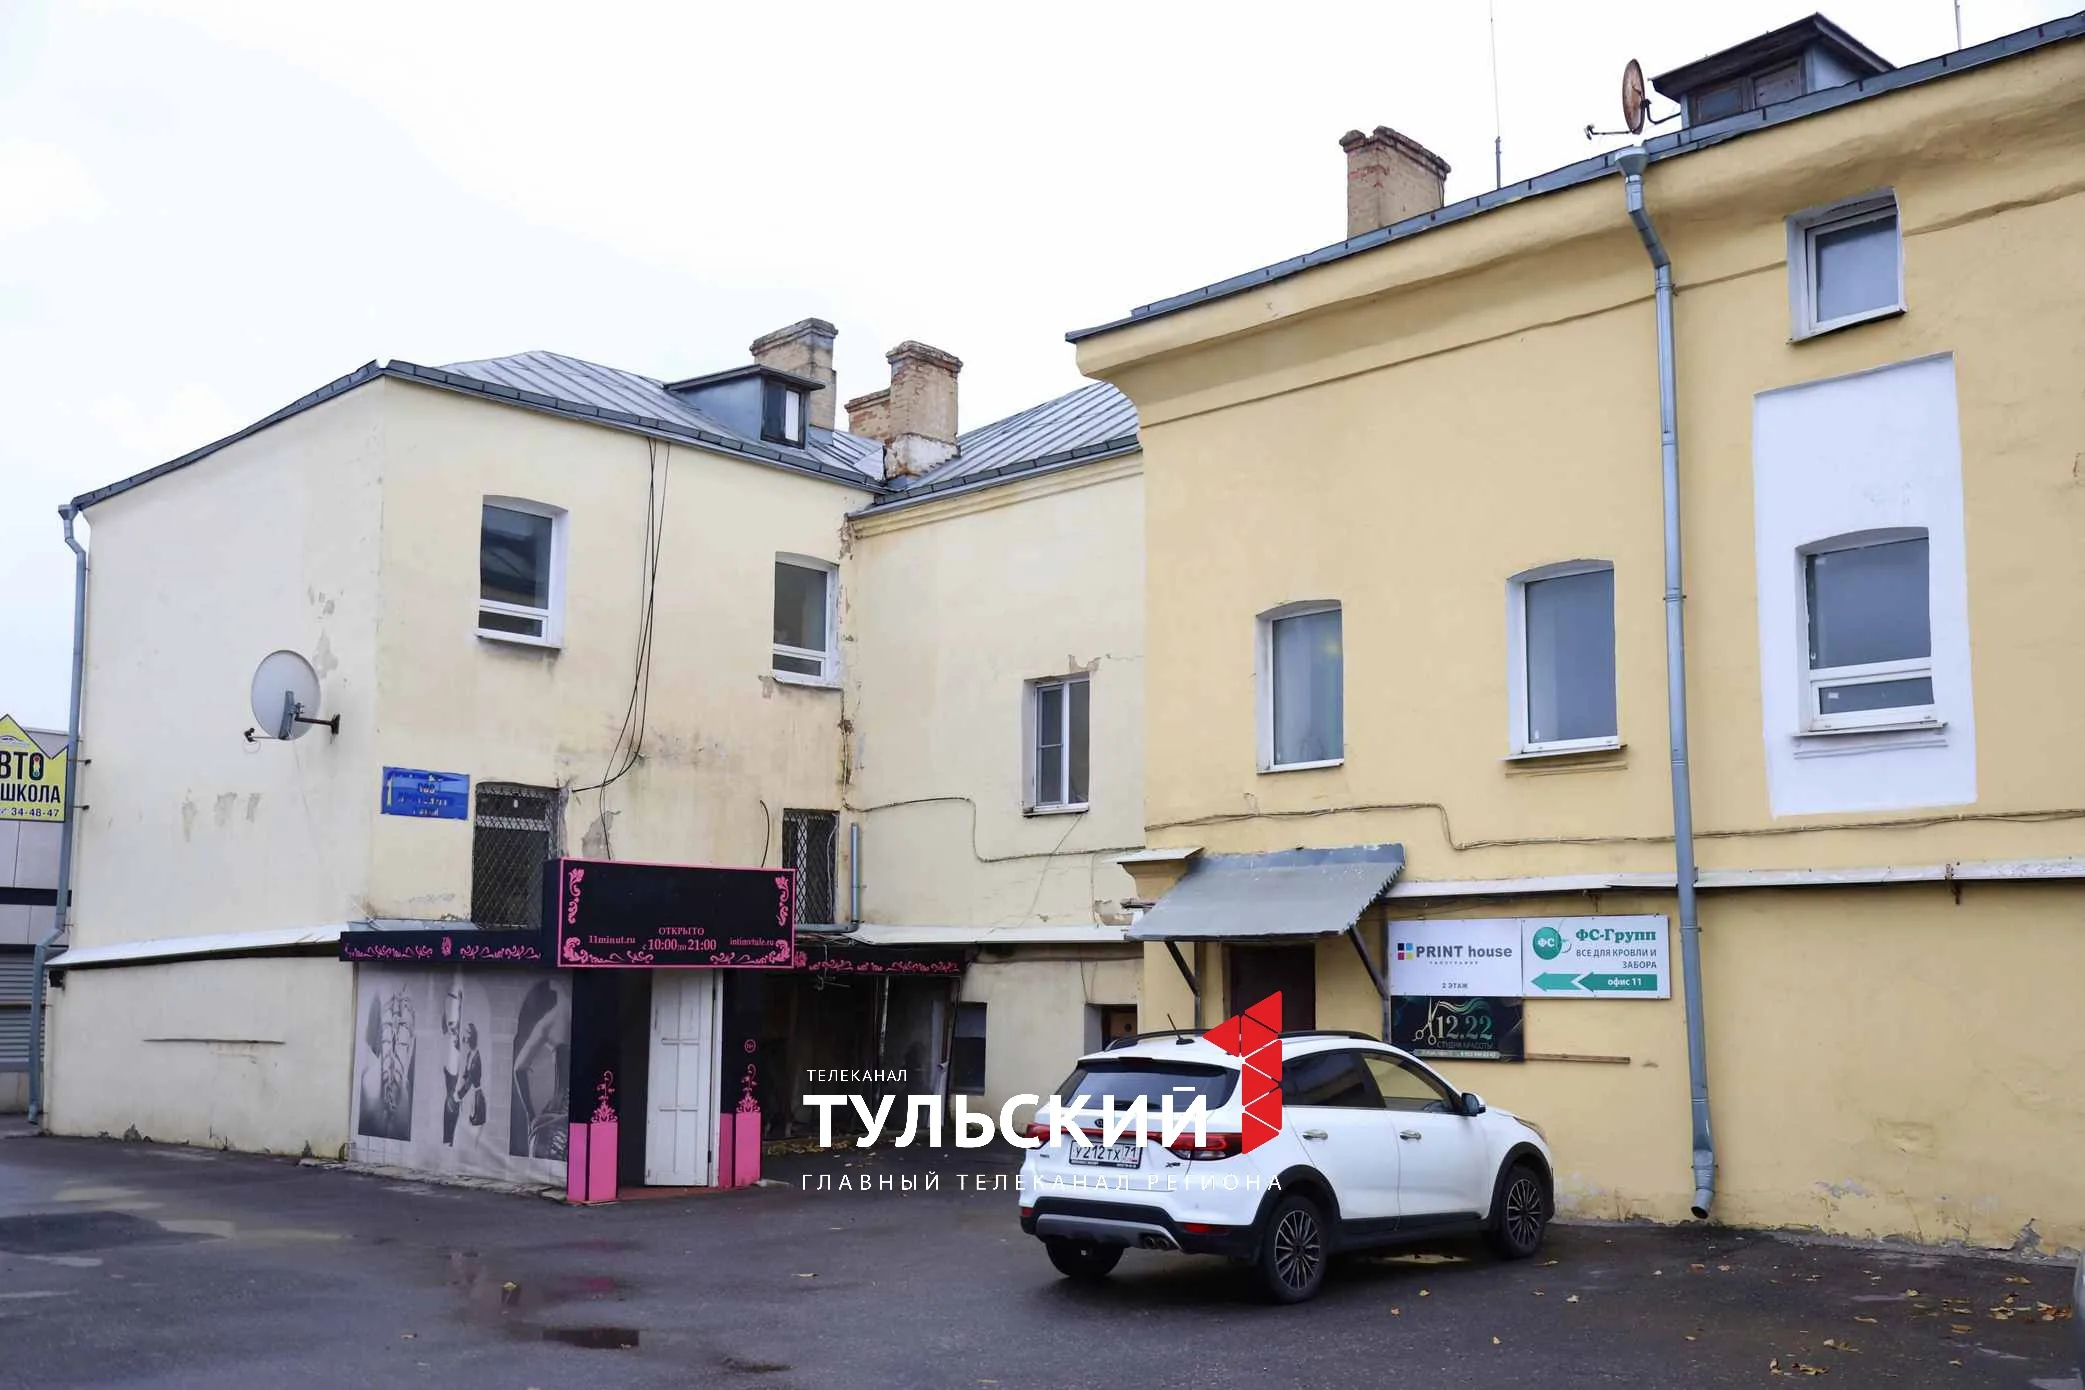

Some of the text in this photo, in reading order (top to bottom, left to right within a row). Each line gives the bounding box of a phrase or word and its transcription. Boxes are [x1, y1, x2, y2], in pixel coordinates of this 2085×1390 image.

[0, 783, 61, 804] ШКОЛА
[11, 808, 60, 817] 34-48-47
[658, 927, 705, 936] ОТКРЫТО
[1575, 928, 1656, 944] ФС-Групп
[648, 939, 678, 951] 10:00
[688, 939, 717, 951] 21:00
[1538, 938, 1555, 947] ФС
[1416, 945, 1513, 958] PRINT house
[1576, 948, 1657, 960] ВСЕ ДЛЯ КРОВЛИ И
[1622, 961, 1657, 969] ЗАБОРА
[1607, 977, 1642, 987] офис 11
[1436, 1015, 1493, 1040] 12.22
[1124, 1146, 1137, 1159] 71
